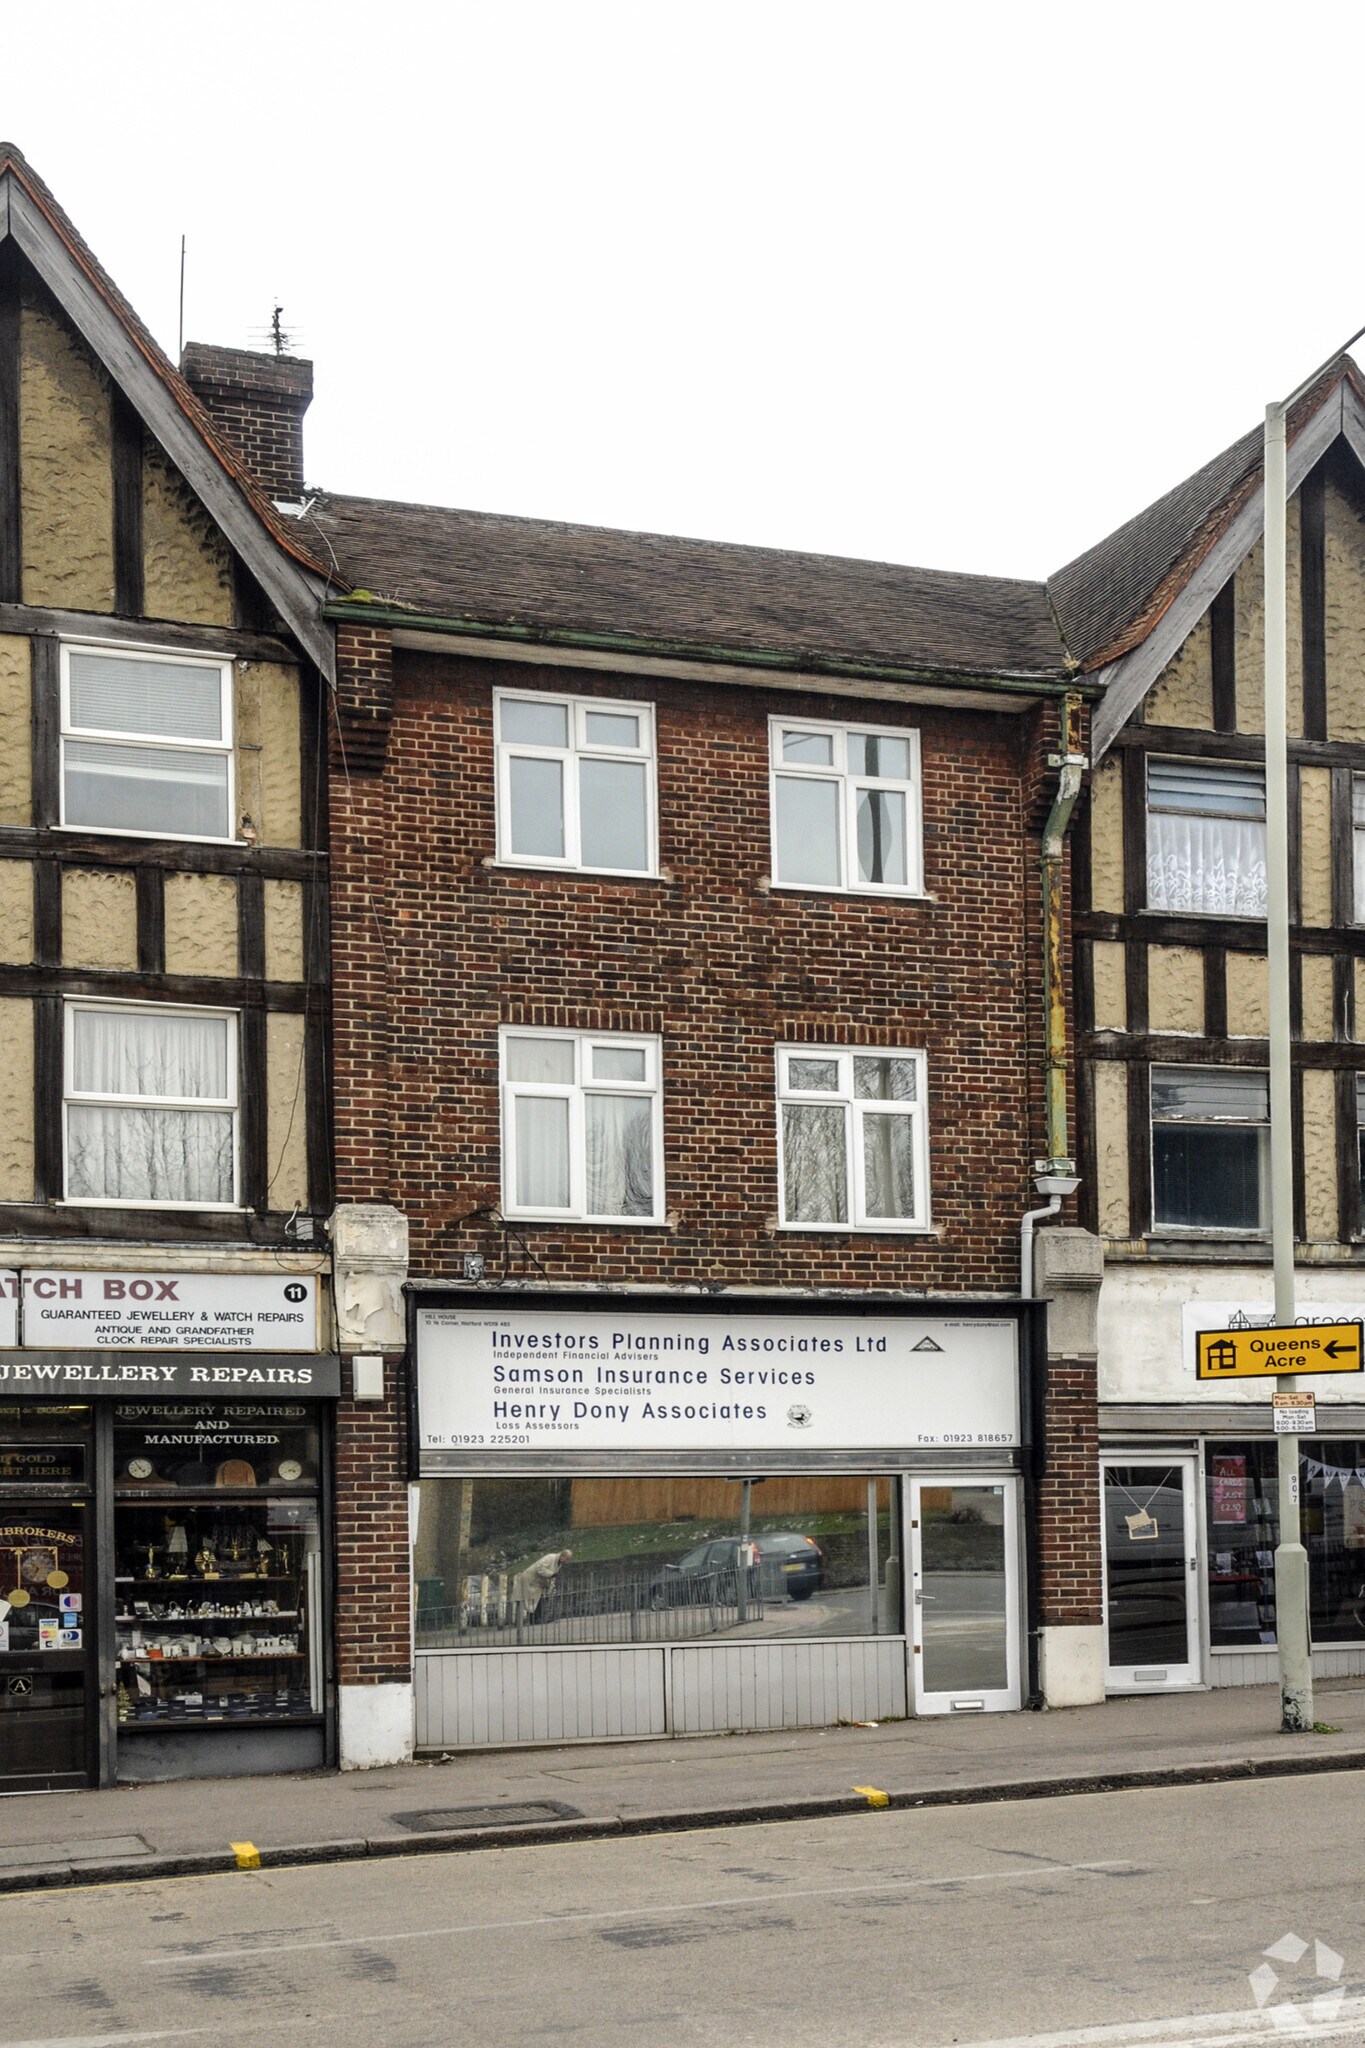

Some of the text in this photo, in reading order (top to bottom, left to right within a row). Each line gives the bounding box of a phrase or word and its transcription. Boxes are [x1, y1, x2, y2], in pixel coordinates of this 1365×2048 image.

[0, 1278, 180, 1301] TCH BOX
[287, 1286, 302, 1299] 11
[41, 1309, 304, 1323] GUARANTEED JEWELLERY & WATCH REPAIRS
[94, 1325, 255, 1336] ANTIQUE AND GRANDFATHER
[97, 1336, 252, 1346] CLOCK REPAIR SPECIALISTS
[492, 1331, 887, 1354] Investors Planning Associates Ltd
[1249, 1339, 1321, 1353] Queens
[493, 1351, 659, 1361] Independent Financial Advisers
[1264, 1355, 1307, 1368] Acre
[0, 1364, 313, 1384] JEWELLERY REPAIRS
[493, 1365, 815, 1385] Samson Insurance Services
[494, 1386, 652, 1396] General Insurance Specialists
[115, 1405, 306, 1417] JEWELLERY REPAIRED
[493, 1401, 561, 1421] Henry
[573, 1402, 630, 1422] Dony
[642, 1402, 767, 1419] Associates
[194, 1420, 230, 1430] AND
[496, 1421, 580, 1430] Loss Assessors
[145, 1434, 278, 1445] MANUFACTURED
[427, 1434, 531, 1444] Tel: 01923 225201
[917, 1434, 1014, 1443] Fax: 01923 818657
[16, 1454, 56, 1463] GOLD
[29, 1467, 71, 1475] HERE
[1224, 1491, 1243, 1499] JUST
[14, 1680, 27, 1691] A
